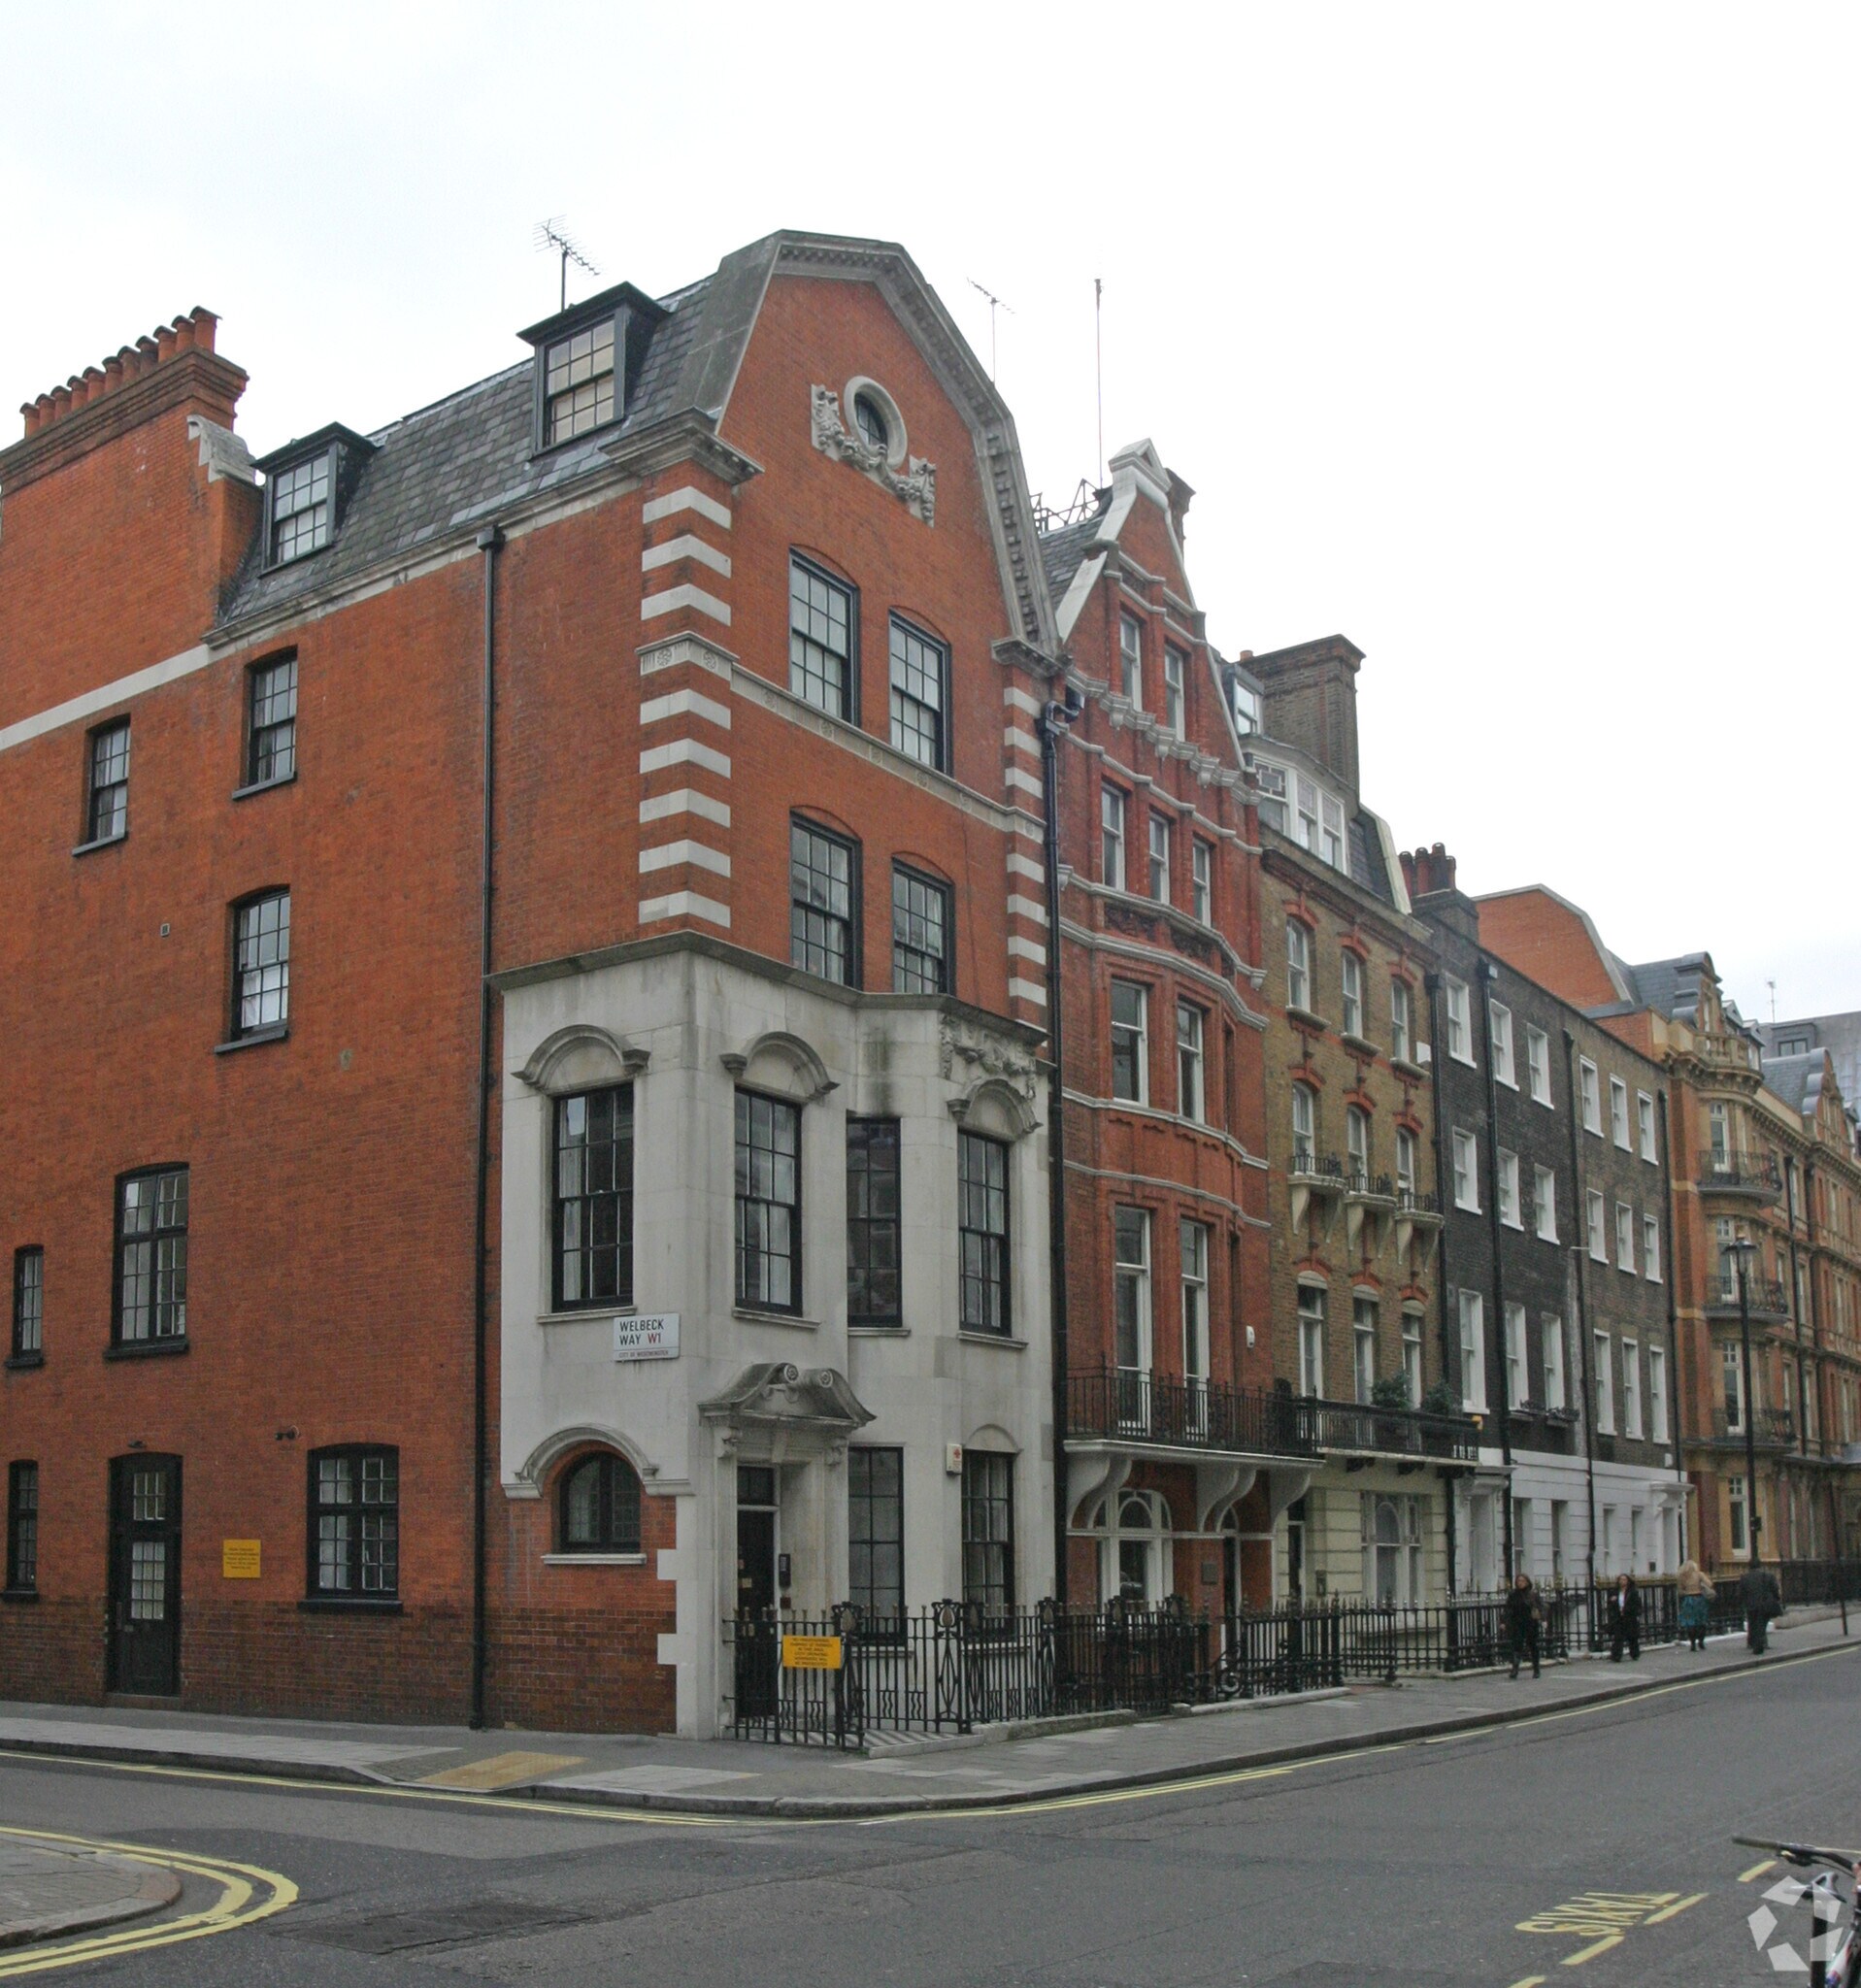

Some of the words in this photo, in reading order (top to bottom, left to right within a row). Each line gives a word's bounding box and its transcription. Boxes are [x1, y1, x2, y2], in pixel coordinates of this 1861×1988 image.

[619, 1318, 664, 1332] WELBECK
[619, 1334, 641, 1345] WAY
[648, 1333, 661, 1343] W1
